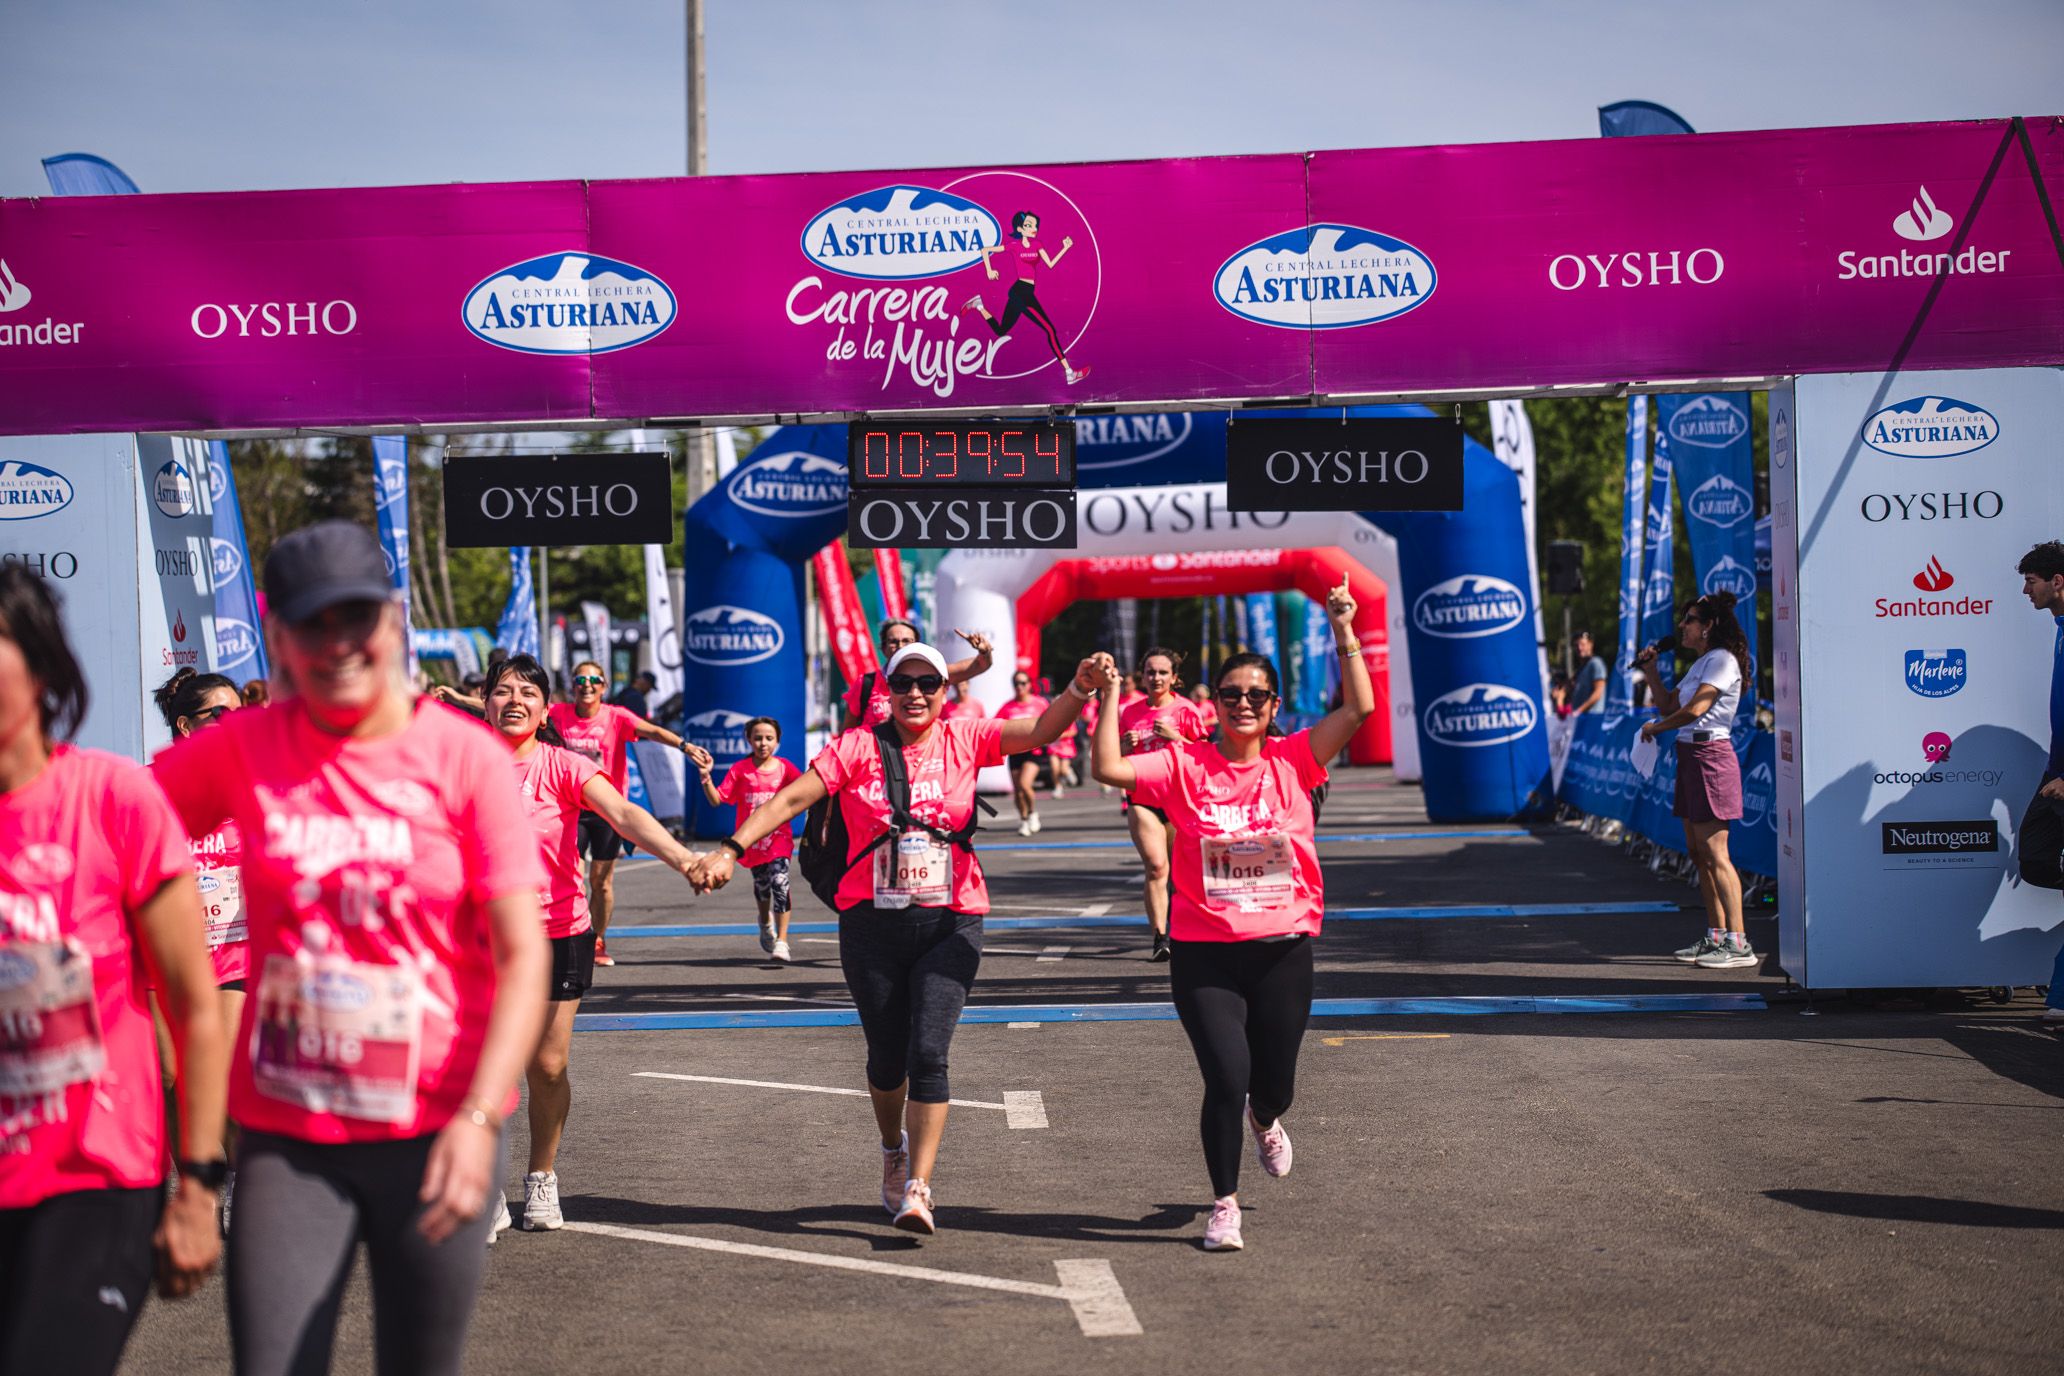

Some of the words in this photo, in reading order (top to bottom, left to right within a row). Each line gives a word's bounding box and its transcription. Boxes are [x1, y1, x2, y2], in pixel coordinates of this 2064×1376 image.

[847, 216, 910, 228] CENTRAL
[915, 214, 979, 227] LECHERA
[817, 222, 986, 258] ASTURIANA
[1265, 261, 1334, 272] CENTRAL
[1341, 257, 1412, 269] LECHERA
[1549, 248, 1725, 292] OYSHO
[1838, 248, 2011, 279] Santander
[512, 288, 580, 299] CENTRAL
[587, 285, 653, 297] LECHERA
[1231, 265, 1420, 304] ASTURIANA
[480, 291, 661, 330] ASTURIANA
[785, 276, 950, 326] Carrera
[191, 299, 357, 339] OYSHO
[826, 326, 857, 361] de
[863, 323, 886, 360] la
[881, 314, 1012, 398] Mujer
[1076, 414, 1174, 445] RIANA
[1871, 419, 1990, 444] ASTURIANA
[1892, 416, 1935, 425] CENTRAL
[1940, 414, 1985, 424] LECHERA
[865, 431, 1059, 478] 00:39:54
[1264, 449, 1430, 485] OYSHO
[480, 483, 639, 521] OYSHO
[736, 473, 849, 502] ASTURIAN
[860, 499, 1066, 542] OYSHO
[1861, 490, 2004, 522] OYSHO
[155, 548, 199, 577] OYSHO
[1421, 601, 1520, 626] ASTURIANA
[1875, 595, 1994, 618] Santander
[163, 647, 199, 667] Santander
[1908, 659, 1964, 686] Marlene
[1431, 709, 1531, 734] ASTURIANA
[1873, 770, 1944, 788] octopus
[1945, 769, 2004, 788] energy
[1889, 828, 1991, 850] Neutrogena
[899, 866, 929, 881] 016
[1232, 865, 1265, 879] 016
